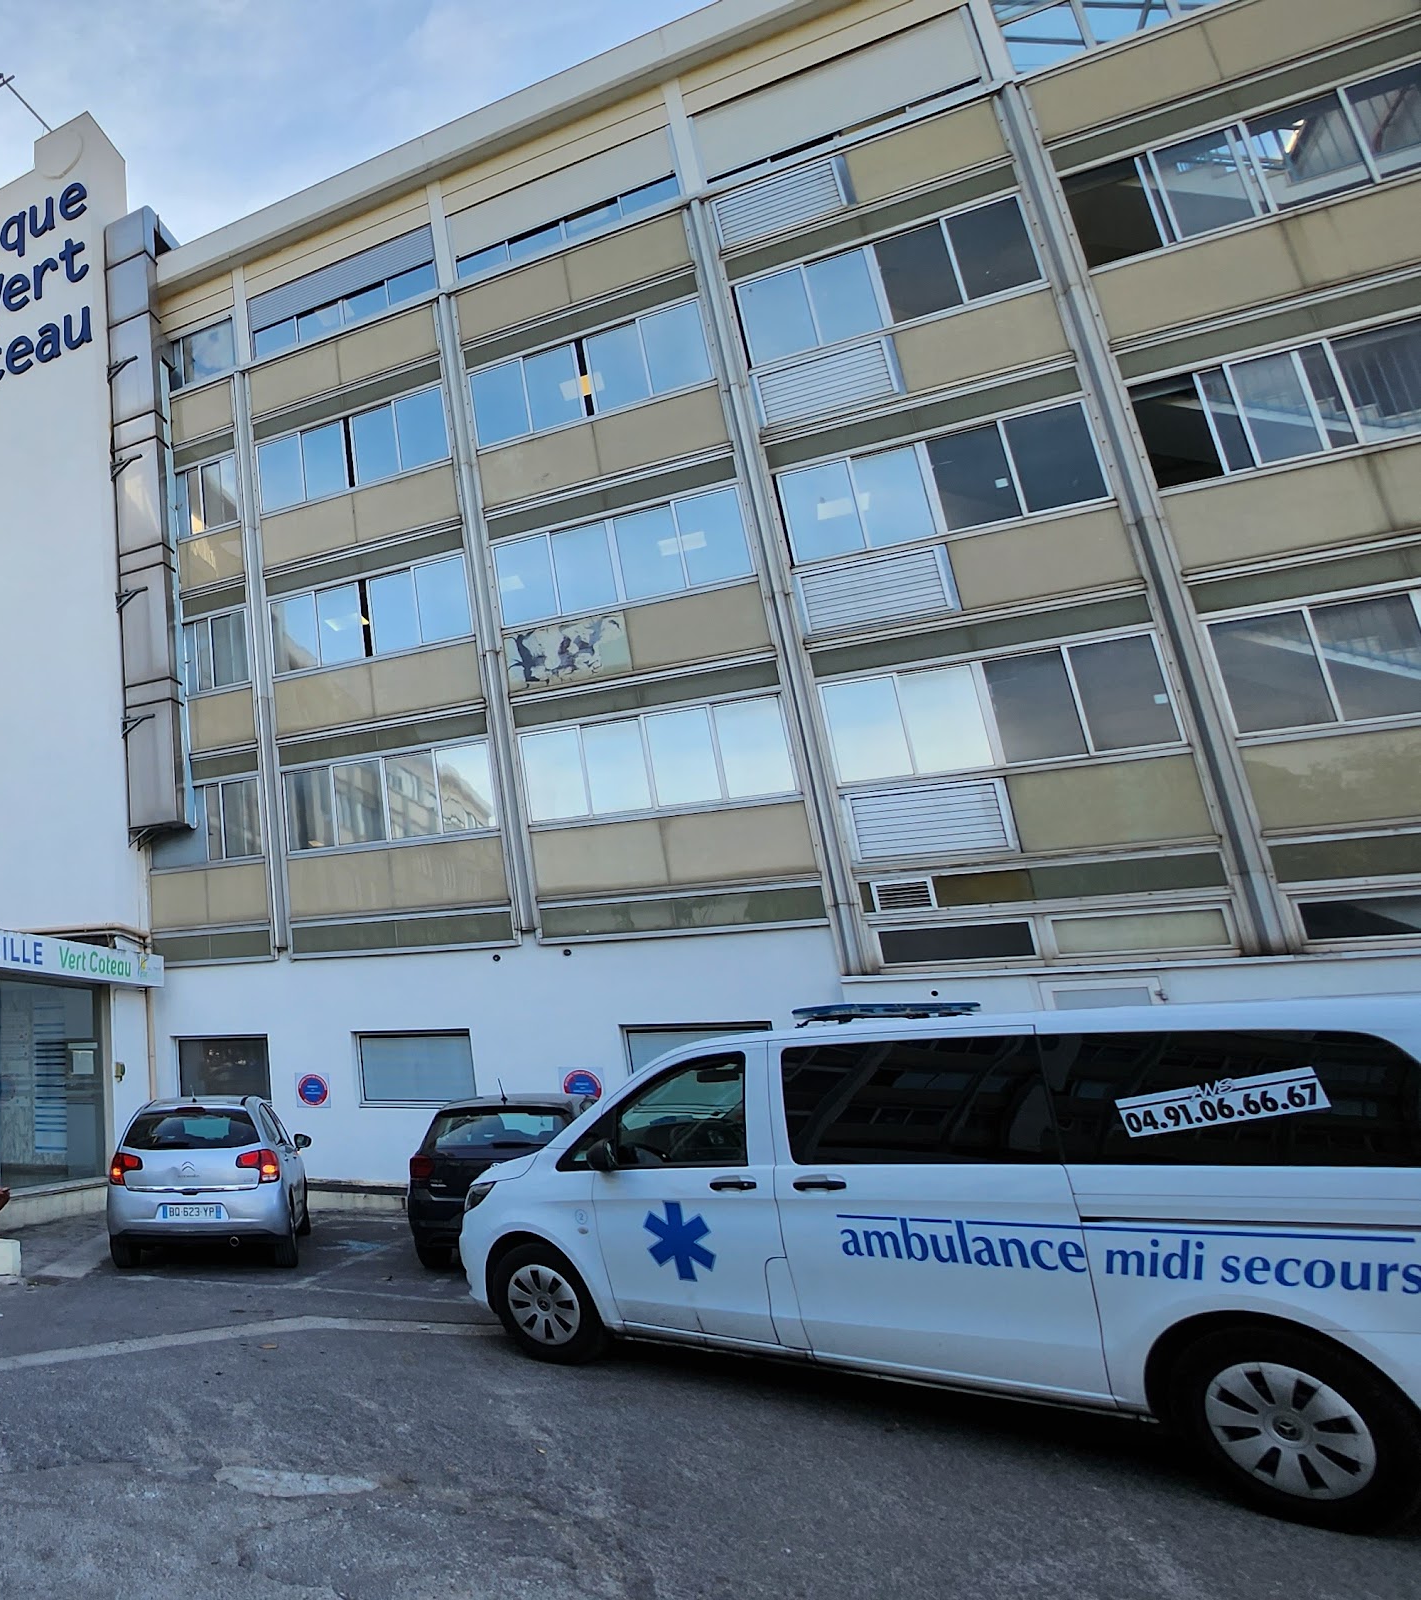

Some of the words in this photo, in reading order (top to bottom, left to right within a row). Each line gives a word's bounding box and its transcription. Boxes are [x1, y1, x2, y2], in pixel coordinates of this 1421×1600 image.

[58, 945, 87, 972] Vert
[89, 950, 132, 978] Coteau
[1125, 1083, 1317, 1133] 04.91.06.66.67
[579, 1213, 584, 1221] 2
[840, 1217, 1087, 1273] ambulance
[1106, 1239, 1205, 1281] midi
[1220, 1254, 1421, 1294] secours
